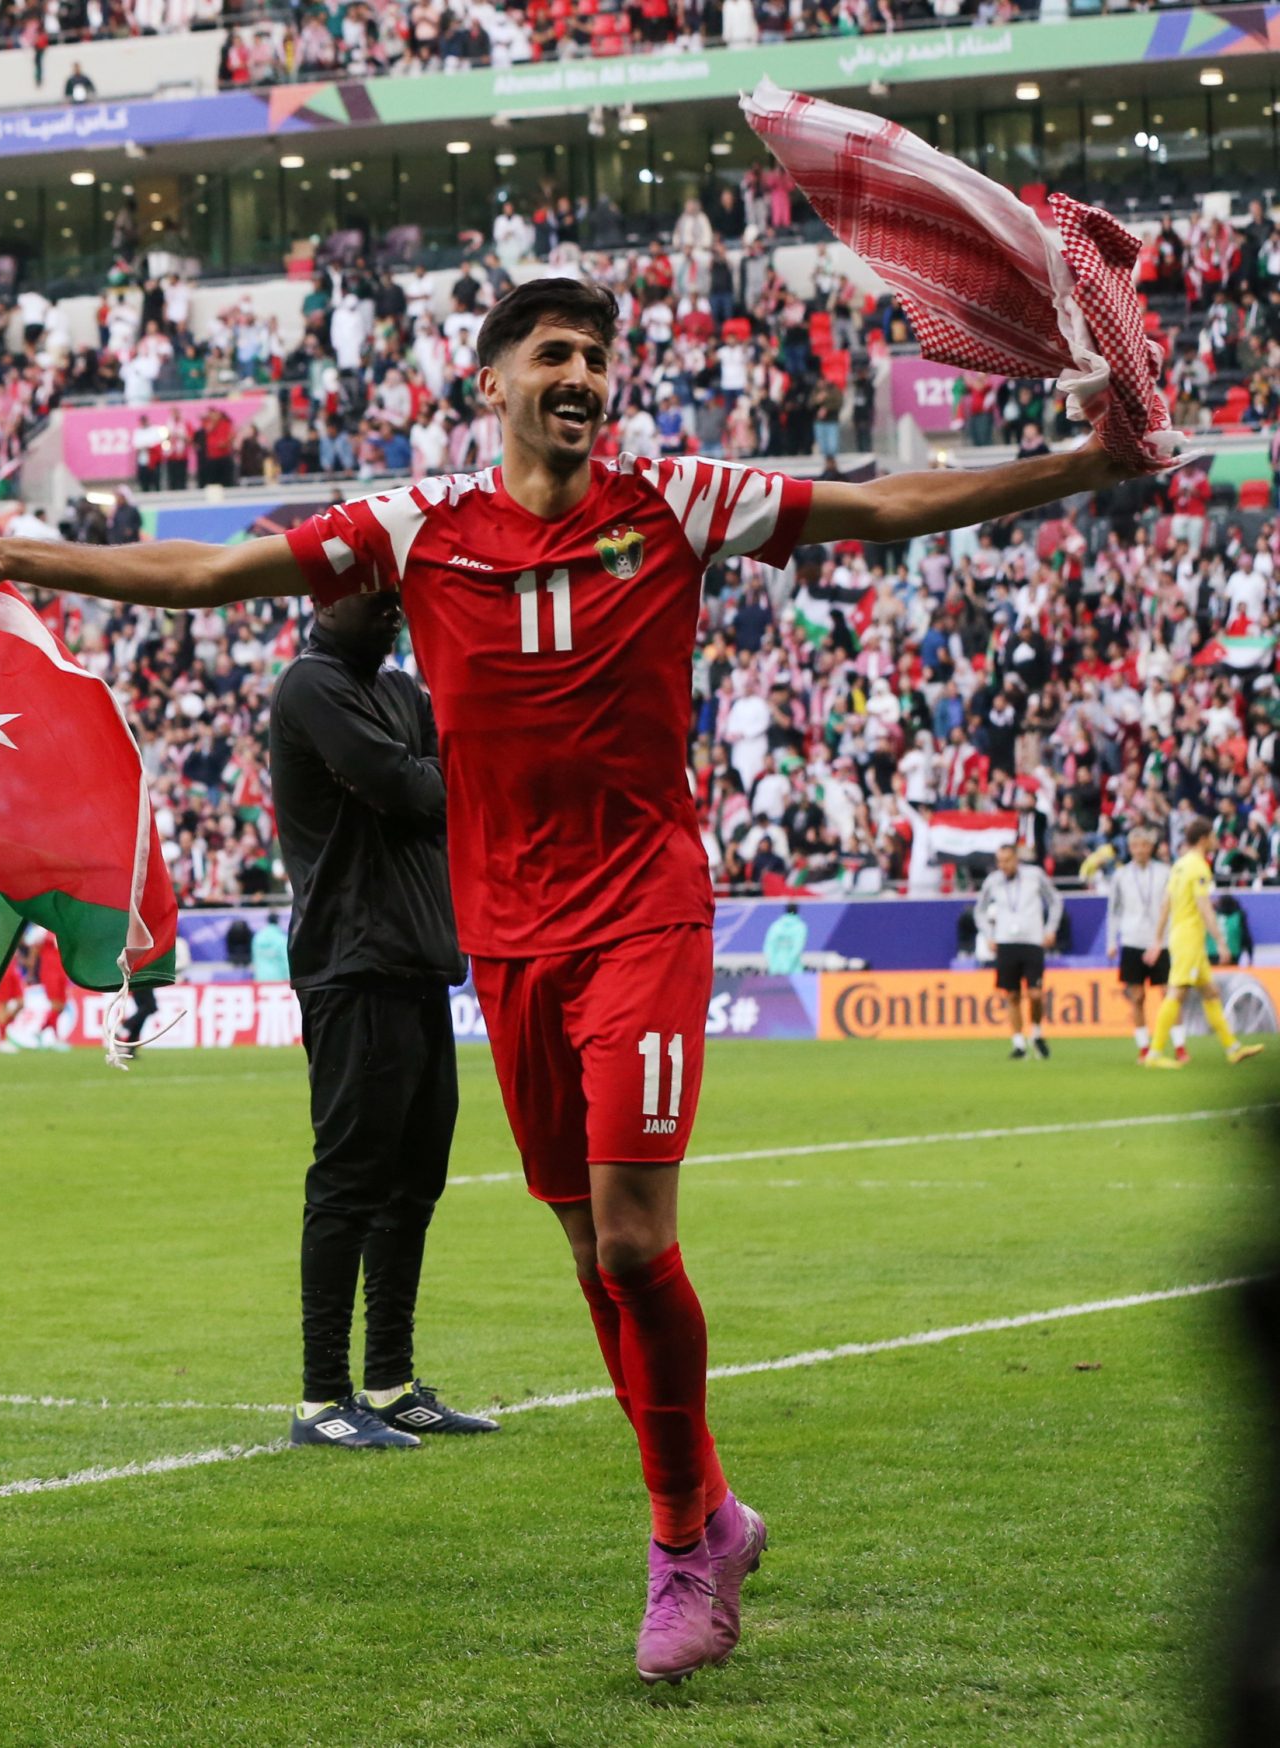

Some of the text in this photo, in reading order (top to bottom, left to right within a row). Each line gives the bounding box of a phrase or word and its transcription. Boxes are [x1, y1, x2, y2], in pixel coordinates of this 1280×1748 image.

[448, 554, 494, 571] JAKO
[514, 568, 573, 653] 11
[834, 981, 1100, 1039] Continetal
[638, 1031, 683, 1117] 11
[642, 1118, 677, 1134] JAKO
